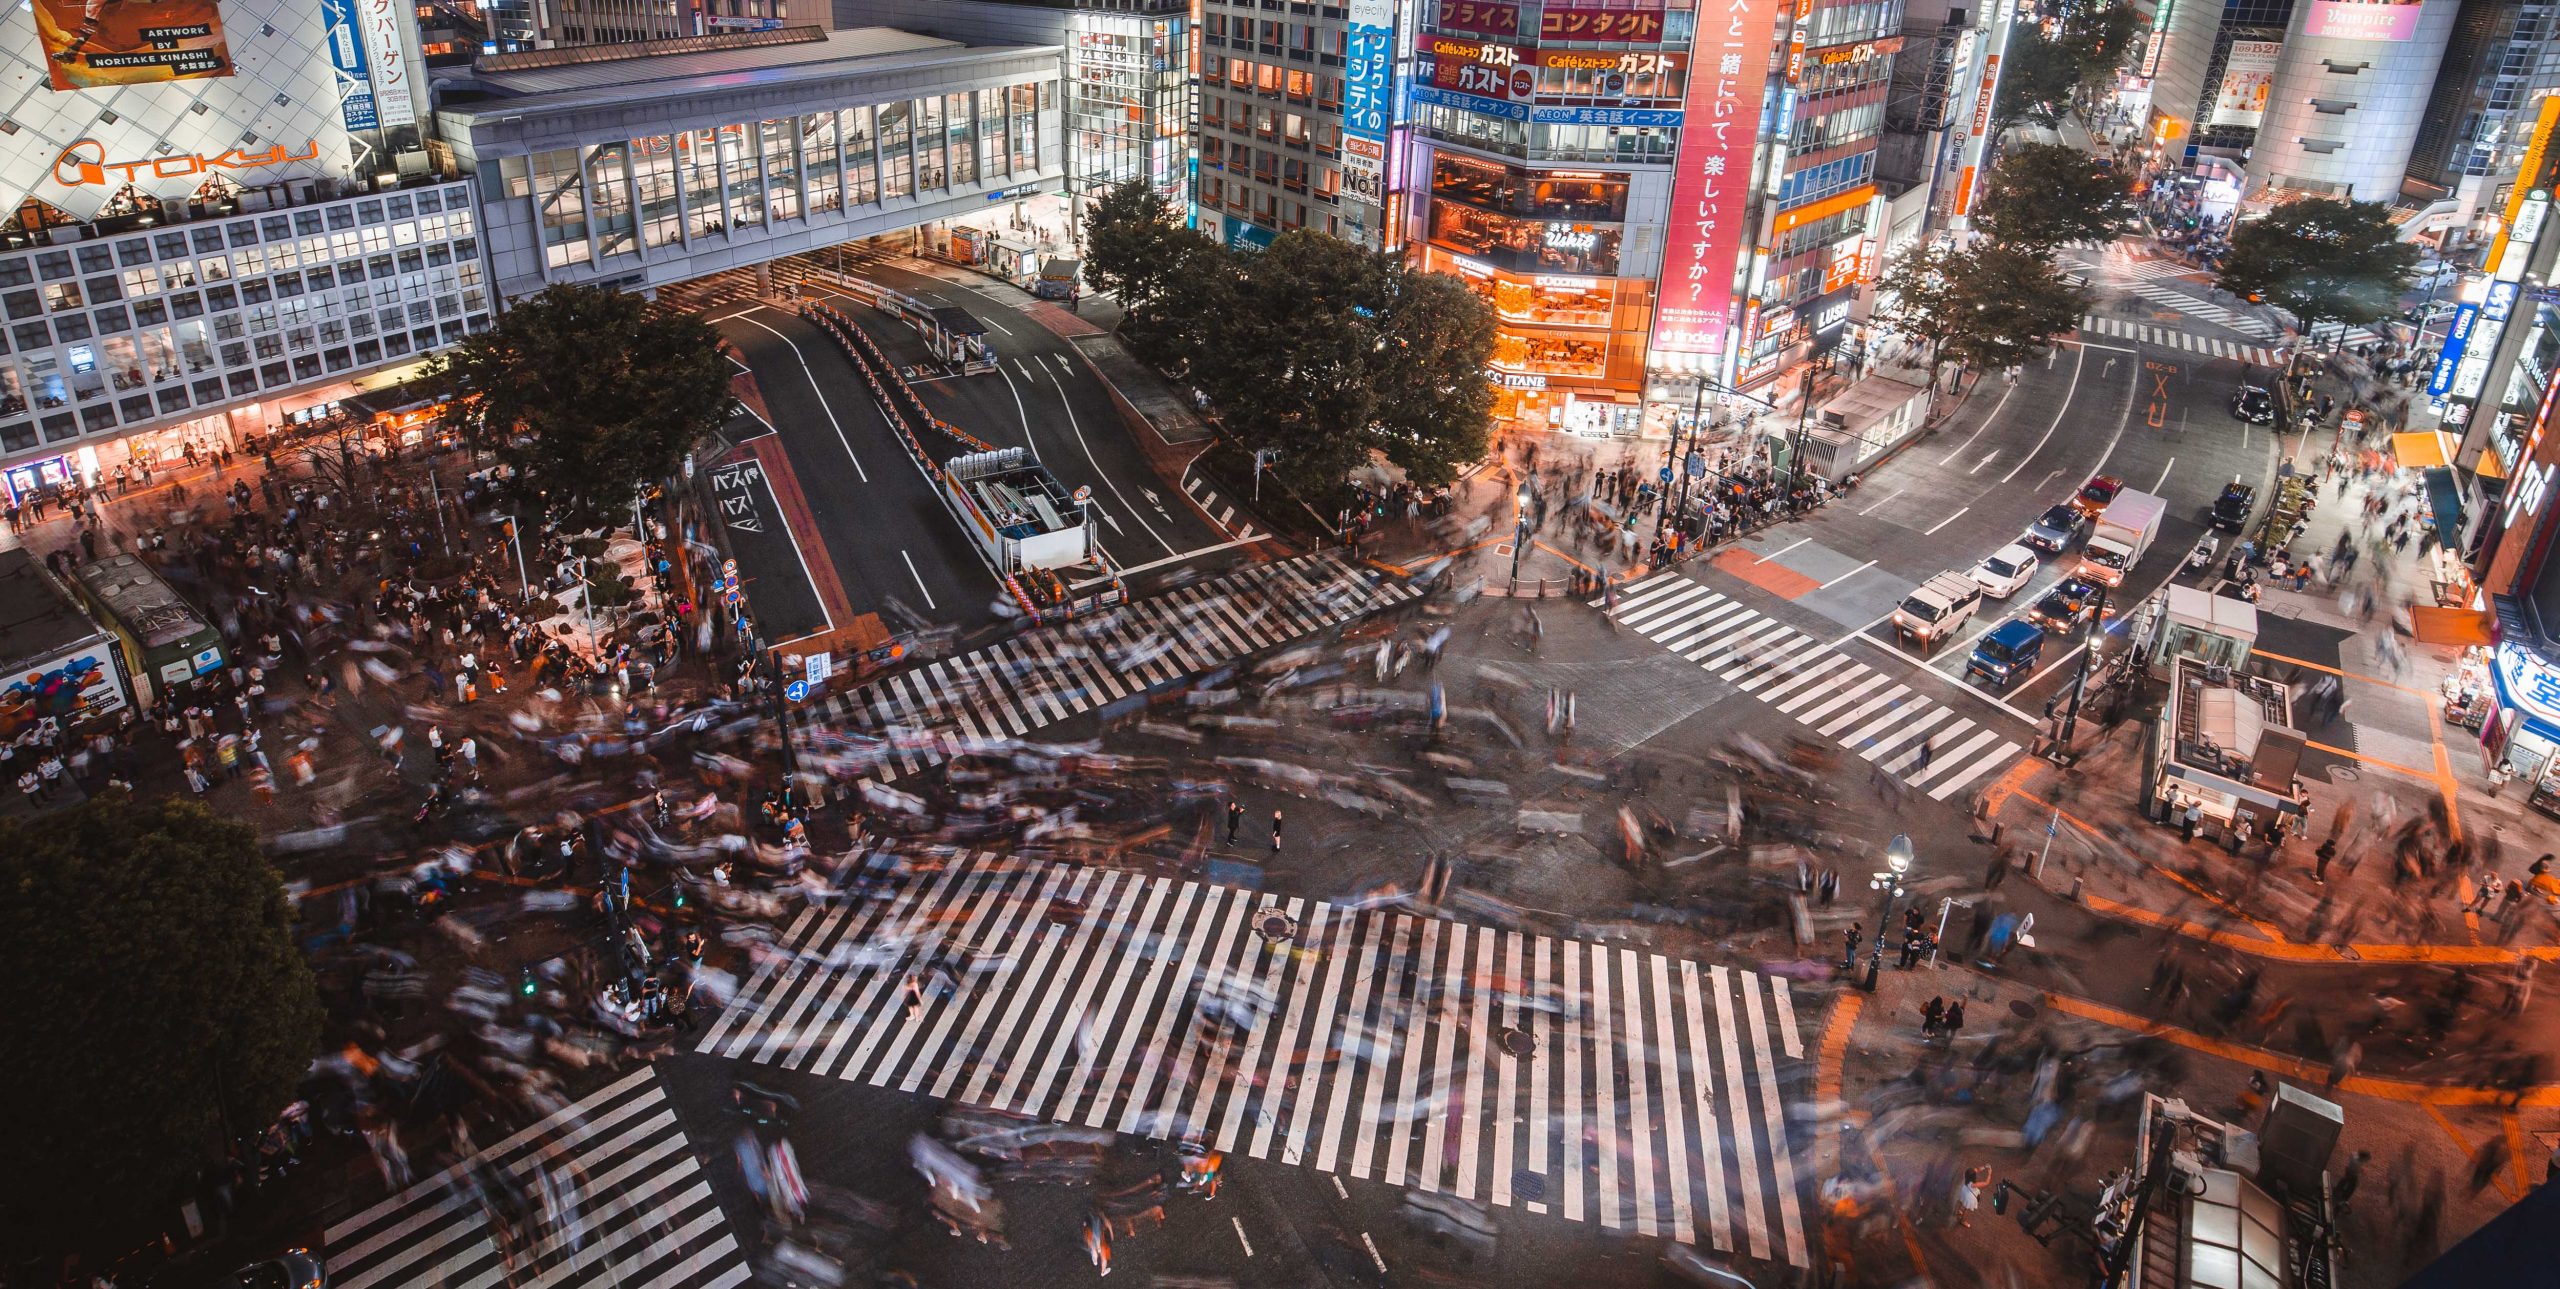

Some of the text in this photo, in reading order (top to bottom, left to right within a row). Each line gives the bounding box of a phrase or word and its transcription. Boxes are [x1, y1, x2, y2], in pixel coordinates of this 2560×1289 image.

[1354, 4, 1388, 20] eyecity
[1441, 2, 1517, 29] プライス
[148, 27, 205, 37] ARTWORK
[1542, 12, 1660, 36] コンタクト
[157, 41, 171, 50] BY
[1480, 44, 1519, 67] ガスト
[95, 51, 208, 67] NORITAKE KINASHI
[1418, 61, 1436, 77] 7F
[1617, 53, 1675, 75] ガスト
[1368, 26, 1387, 130] ンタクトの
[1458, 65, 1505, 93] ガスト
[1538, 109, 1680, 124] AEON 英会話イーオン
[104, 140, 320, 183] TOKYU
[1341, 163, 1382, 200] No.1
[1818, 300, 1850, 329] LUSH
[1673, 328, 1719, 345] tinder
[713, 467, 759, 492] バス停
